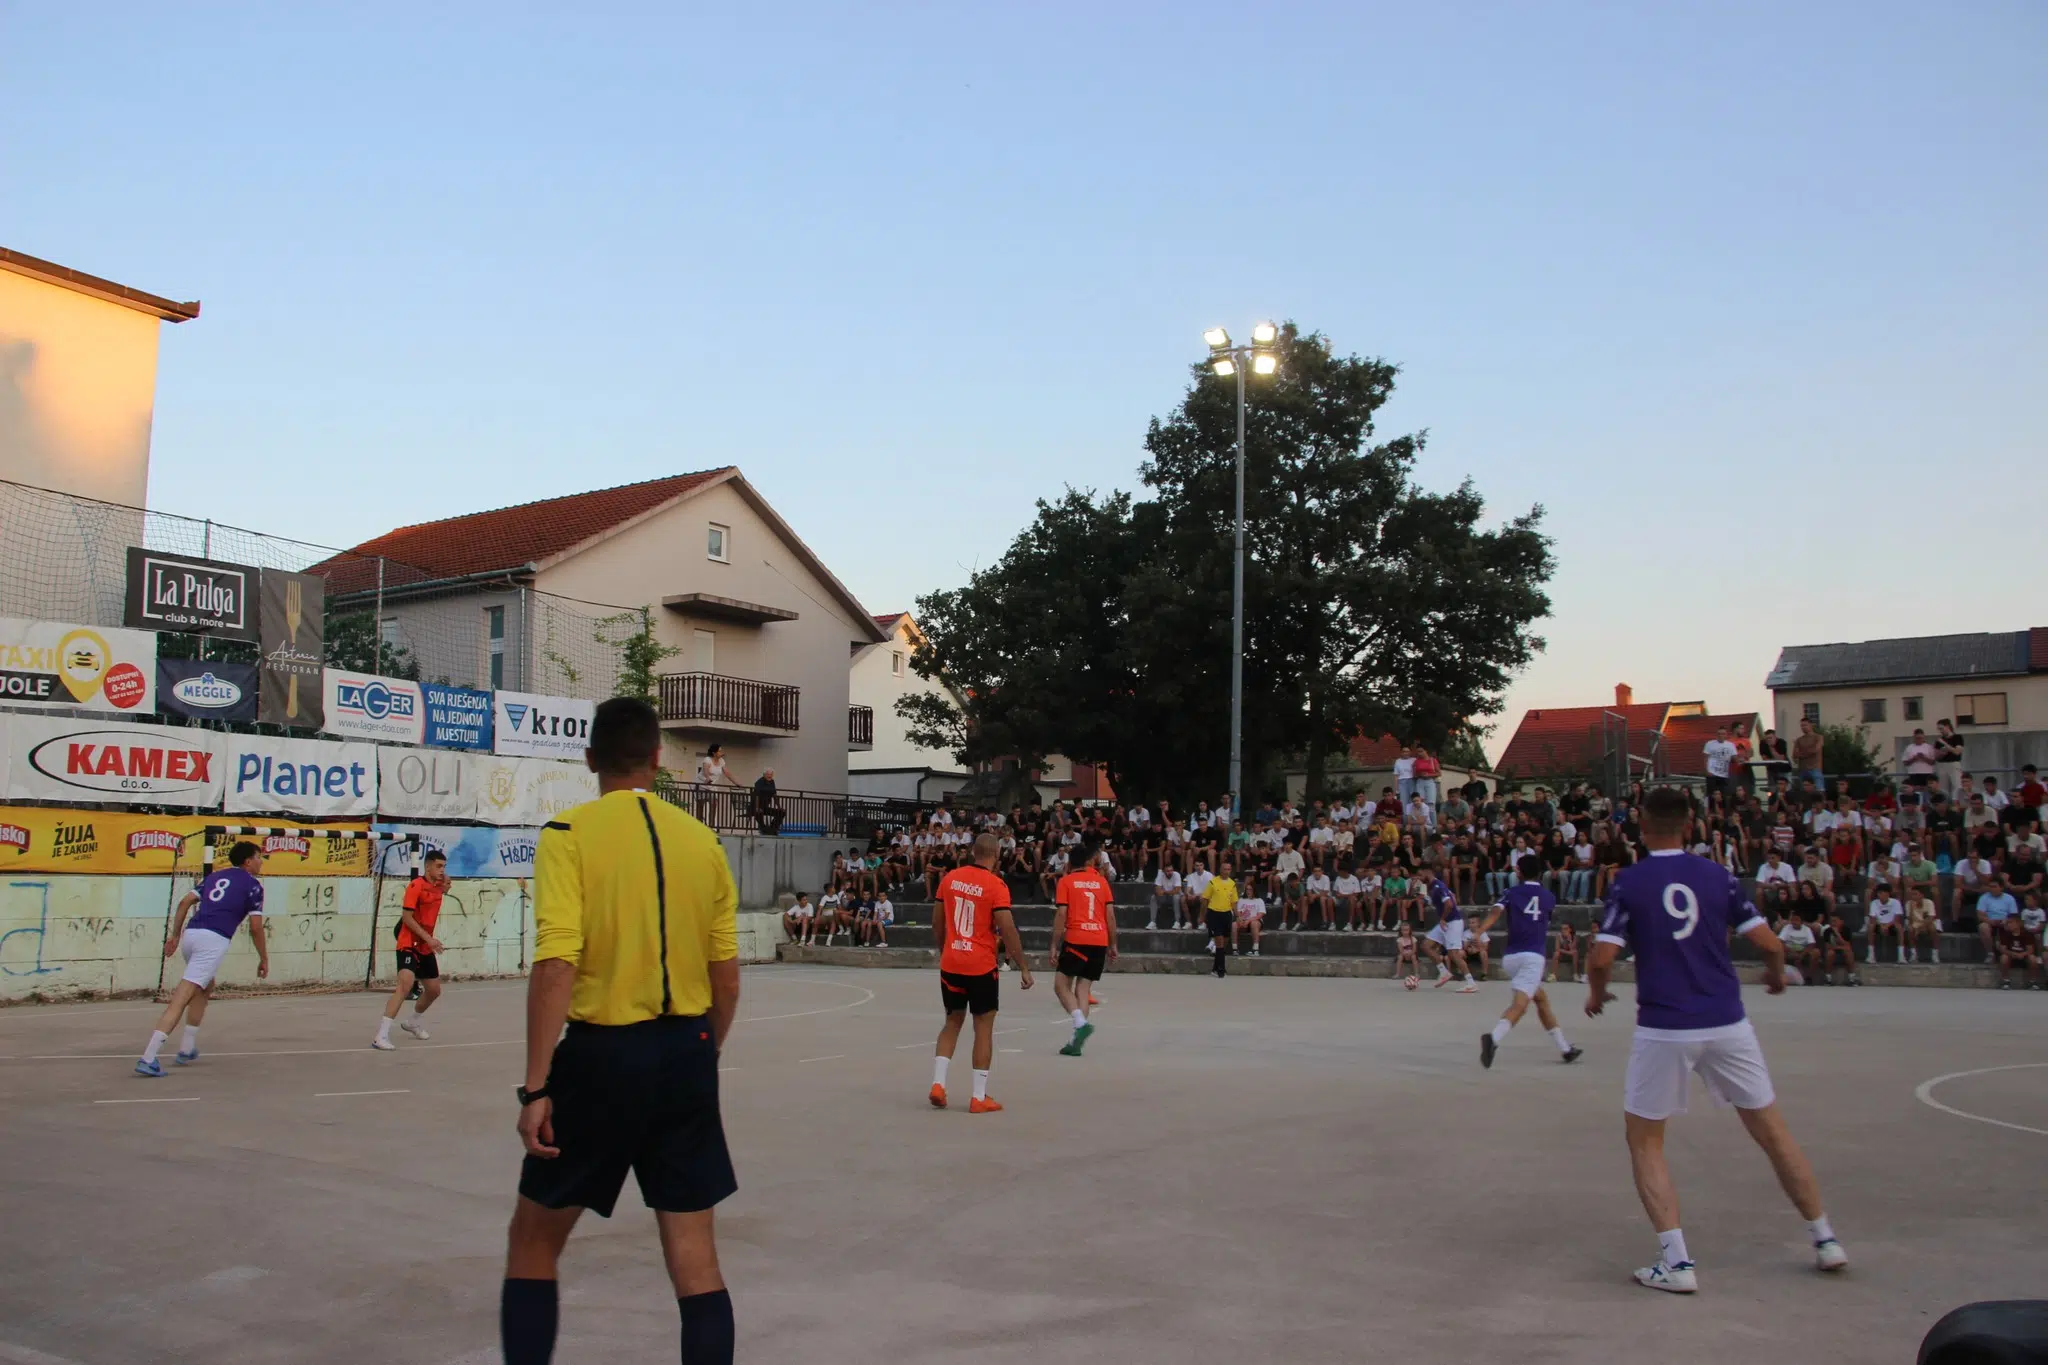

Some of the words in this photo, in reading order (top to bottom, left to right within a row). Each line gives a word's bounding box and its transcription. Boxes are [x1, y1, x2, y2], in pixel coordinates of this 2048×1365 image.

[155, 569, 178, 606] La
[182, 573, 235, 617] Pulga
[165, 613, 187, 624] club
[190, 616, 197, 625] &
[200, 618, 224, 628] more
[266, 662, 319, 675] RESTORAN
[112, 680, 137, 693] 0-24h
[184, 685, 232, 698] MEGGLE
[339, 682, 412, 718] LAGER
[428, 690, 446, 705] SVA
[447, 691, 488, 710] RJEŠENJA
[338, 719, 411, 735] www.lager-doo.com
[433, 709, 446, 722] NA
[447, 710, 484, 727] JEDNOM
[436, 728, 479, 744] MJESTU!!!
[66, 743, 213, 783] KAMEX
[121, 777, 153, 790] d.o.o.
[236, 753, 366, 798] Planet
[397, 754, 461, 796] OLI
[54, 821, 96, 846] ŽUJA
[52, 846, 62, 858] JE
[64, 842, 98, 856] ZAKON!
[208, 878, 230, 902] 8
[954, 895, 975, 938] 10
[1524, 896, 1542, 921] 4
[1662, 883, 1699, 940] 9
